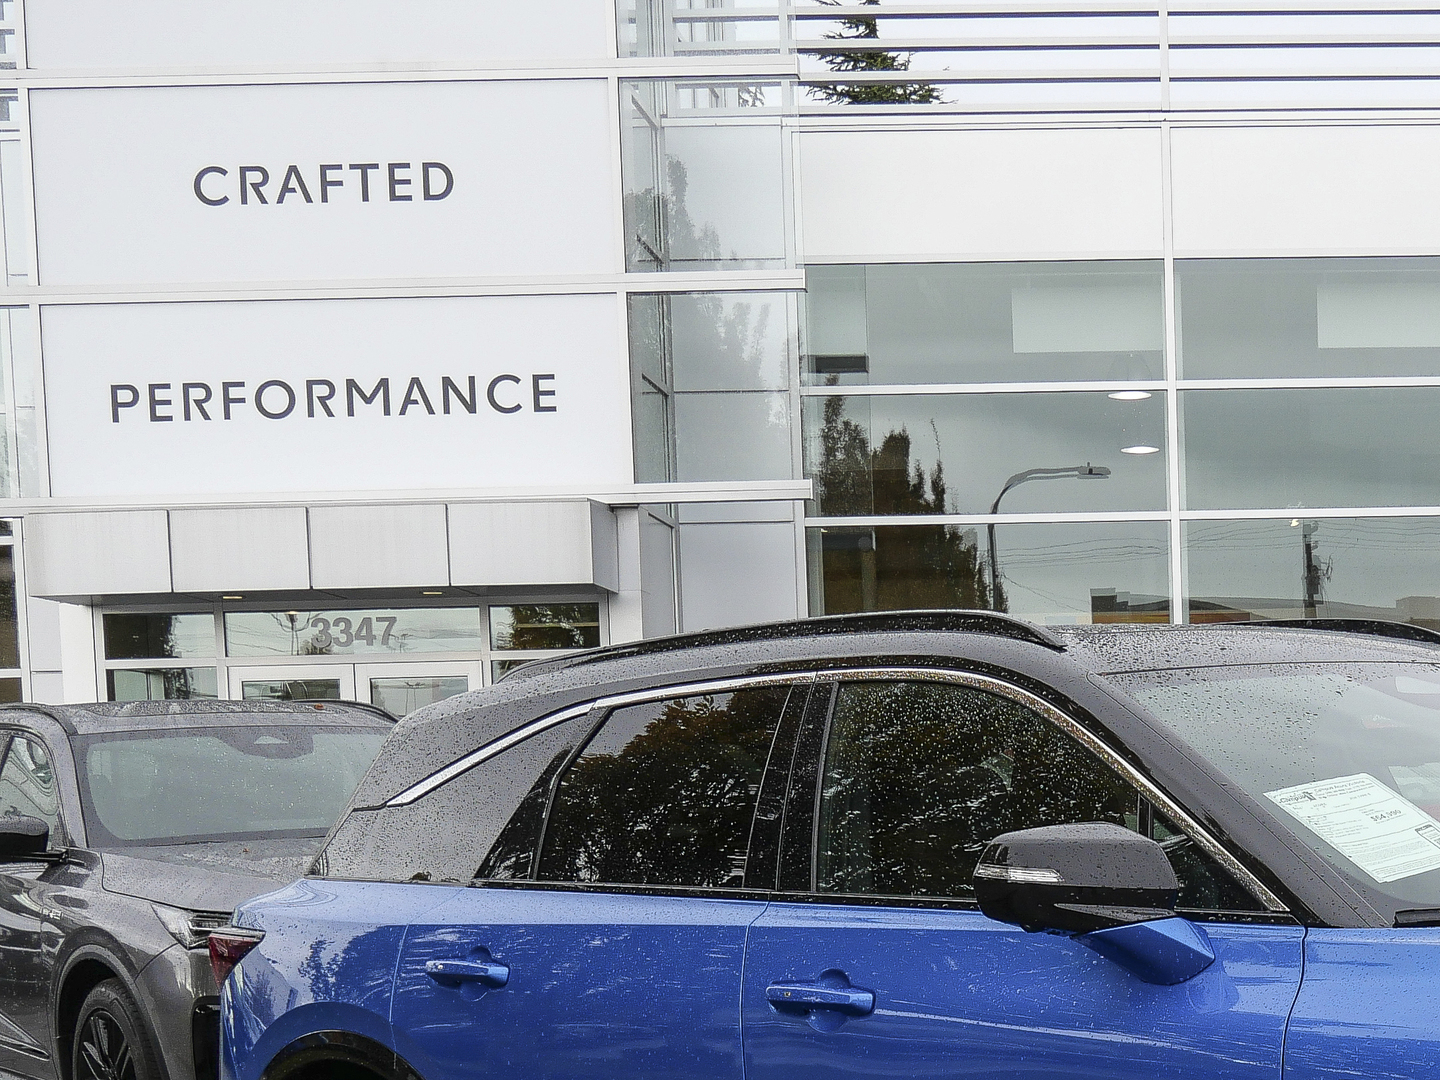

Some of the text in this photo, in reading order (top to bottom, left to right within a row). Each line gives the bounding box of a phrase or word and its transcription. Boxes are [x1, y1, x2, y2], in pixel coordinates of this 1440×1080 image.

[193, 161, 454, 207] CRAFTED
[110, 373, 557, 423] PERFORMANCE
[310, 616, 397, 648] 3347
